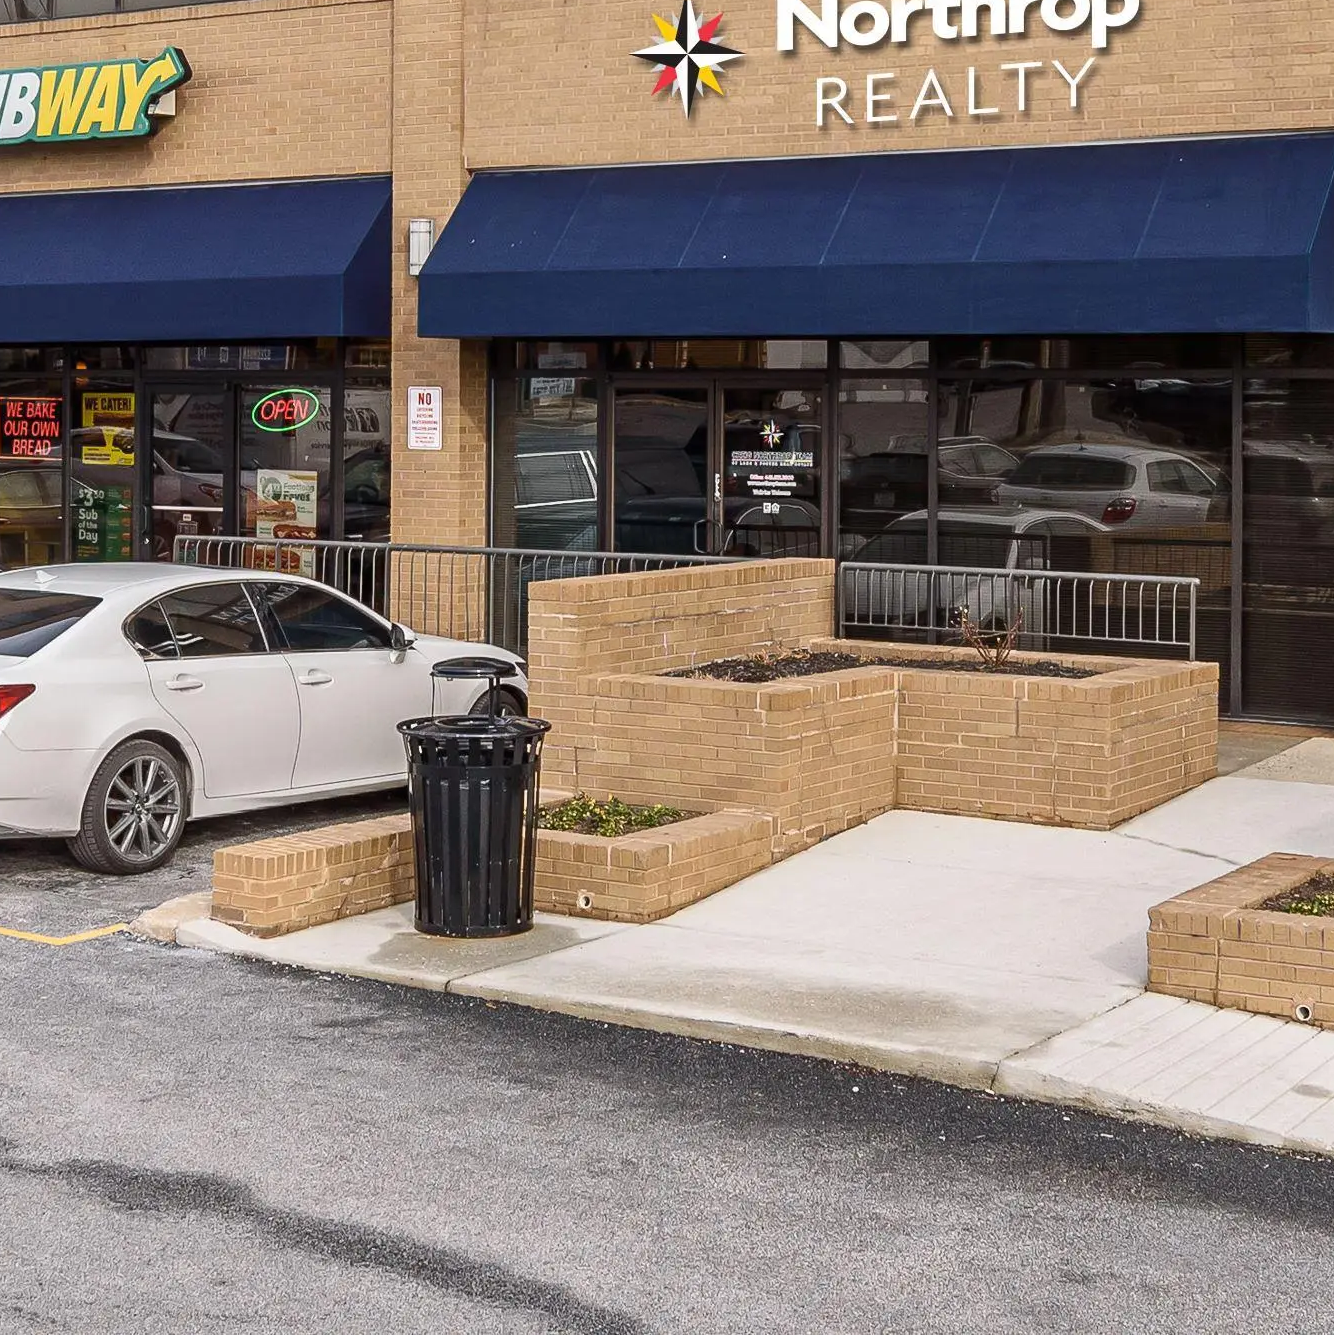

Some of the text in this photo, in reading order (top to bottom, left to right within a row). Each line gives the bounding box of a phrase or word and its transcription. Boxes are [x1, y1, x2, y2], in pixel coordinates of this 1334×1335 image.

[816, 57, 1096, 126] REALTY
[418, 392, 432, 405] NO
[7, 401, 56, 419] WE BAKE
[260, 399, 310, 421] OPEN
[4, 420, 60, 437] OUR OWN
[12, 439, 51, 456] BREAD
[78, 508, 98, 520] Sub
[78, 521, 86, 529] of
[78, 529, 98, 543] Day
